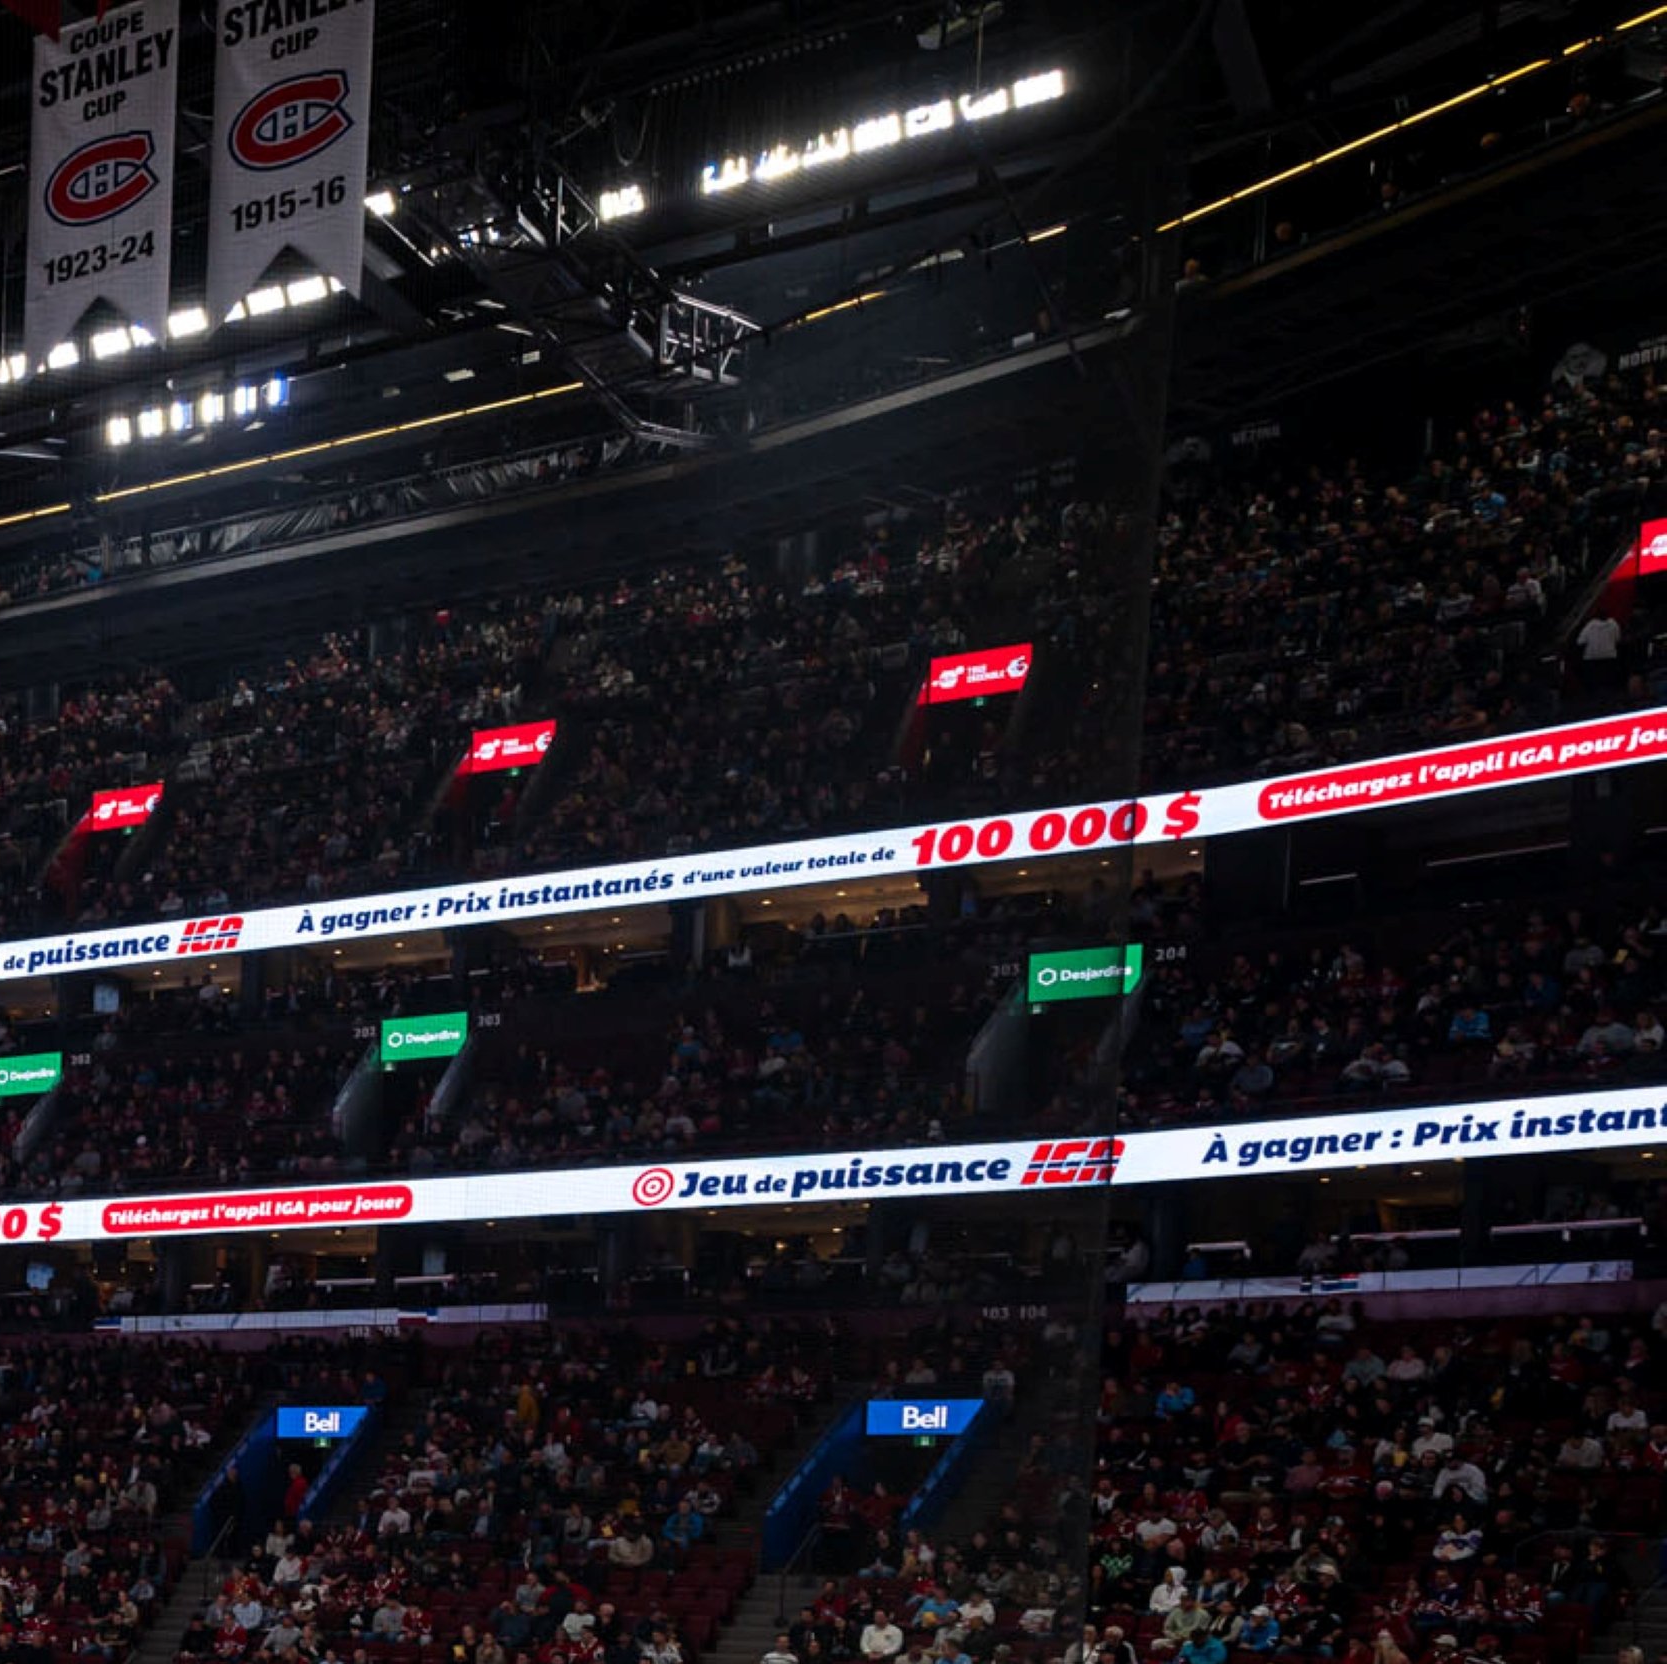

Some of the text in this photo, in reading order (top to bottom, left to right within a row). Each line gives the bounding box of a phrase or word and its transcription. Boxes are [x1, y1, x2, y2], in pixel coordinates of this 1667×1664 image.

[70, 11, 144, 55] COUPE
[271, 27, 319, 60] CUP
[39, 30, 174, 107] STANLEY
[83, 91, 126, 121] CUP
[231, 176, 345, 232] 1915-16
[43, 231, 155, 285] 1923-24
[1268, 735, 1624, 810] Téléchargez l'appli IGA pour
[297, 791, 1202, 934] À gagner Prix instantanés d'une valeur totale 100 000 $
[4, 952, 26, 971] de
[28, 933, 170, 974] puissance
[1060, 965, 1132, 984] Desjardins
[1203, 1115, 1499, 1166] À gagner Prix
[679, 1139, 1125, 1198] Jeu de puissance IGA
[38, 1200, 64, 1241] $
[109, 1194, 404, 1226] Téléchargez pour jouer
[304, 1412, 339, 1433] Bell
[902, 1405, 947, 1430] Bell
